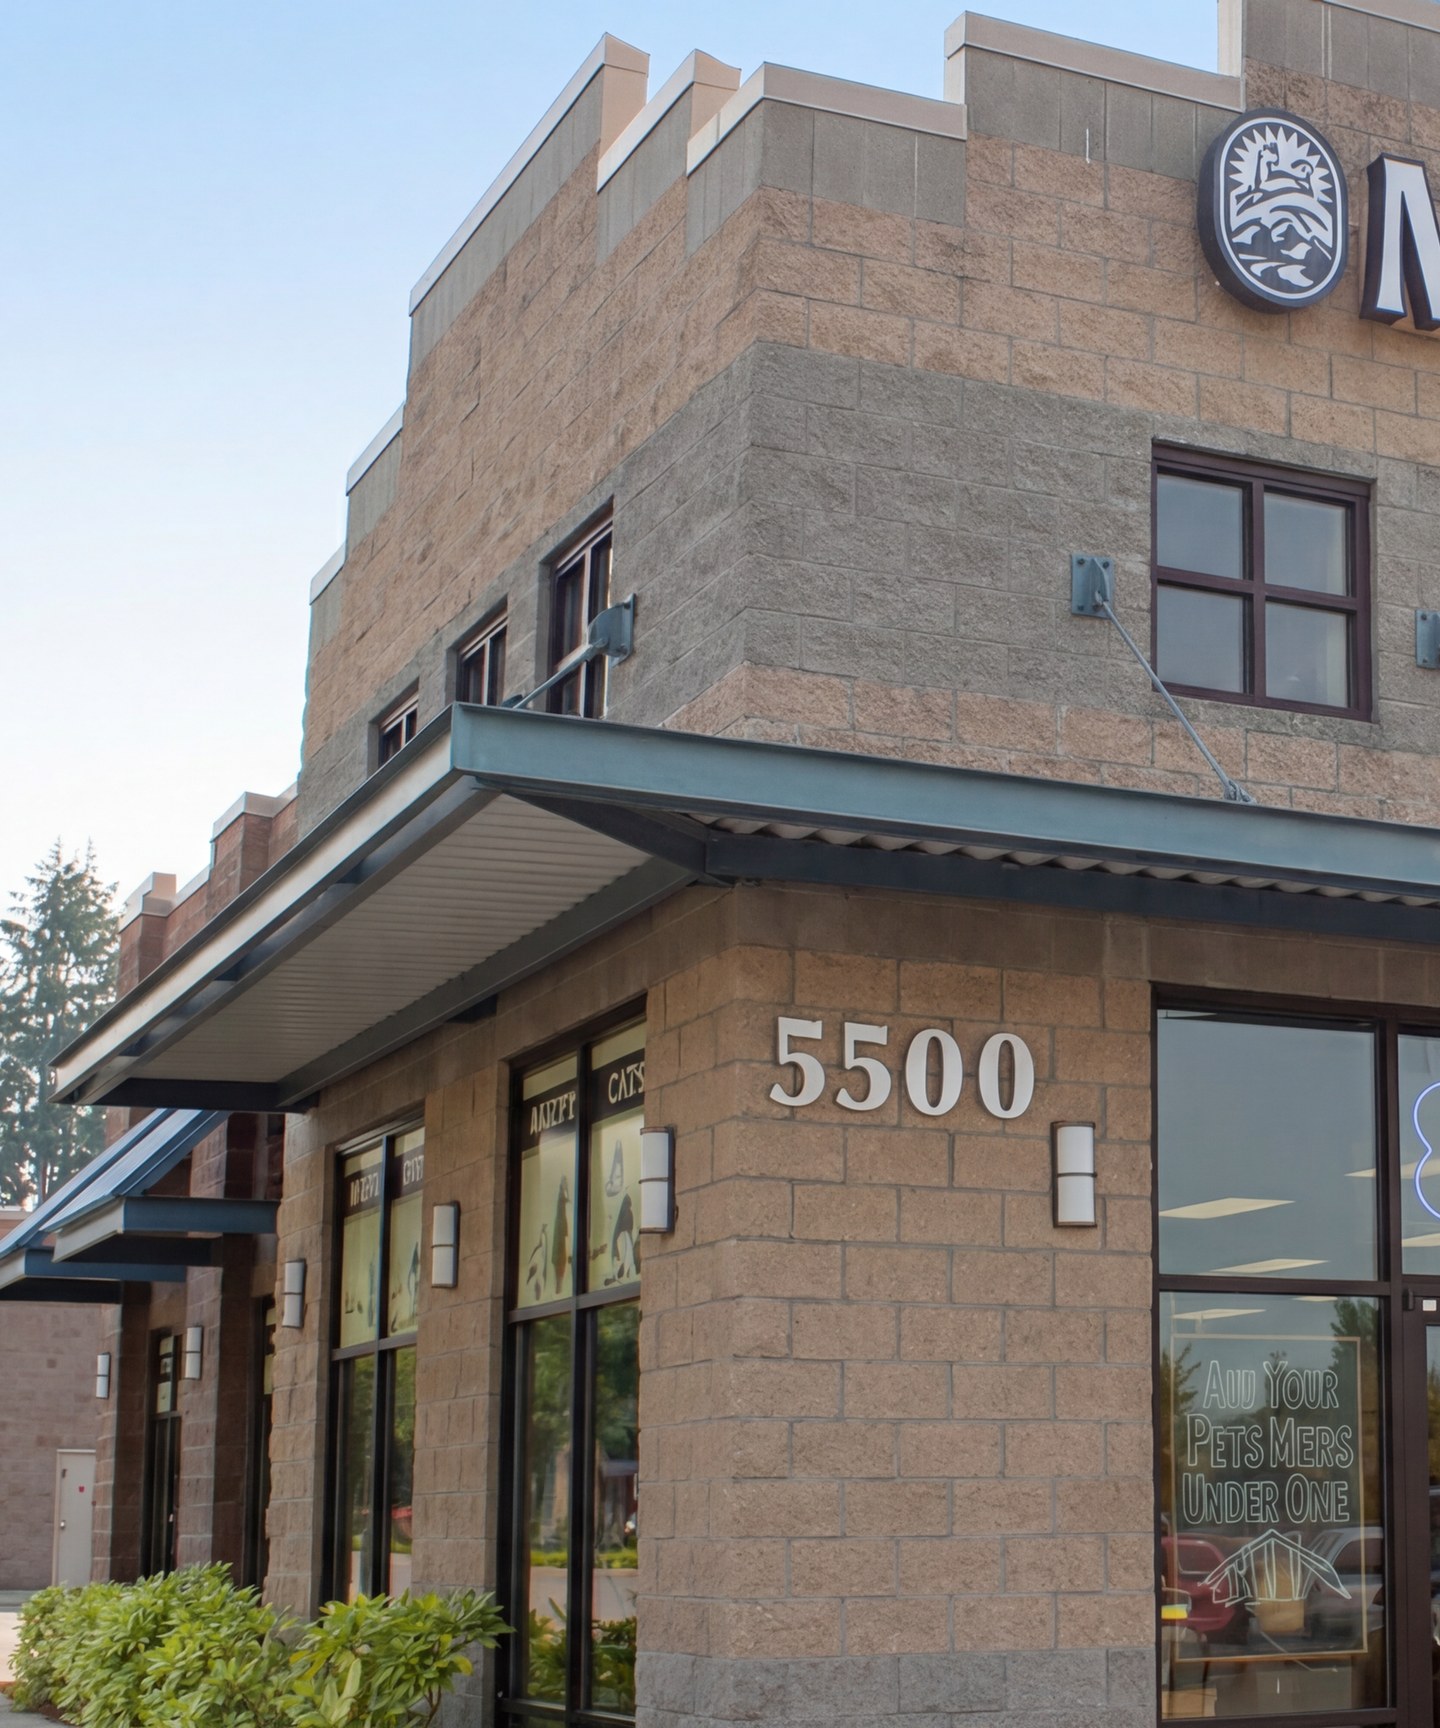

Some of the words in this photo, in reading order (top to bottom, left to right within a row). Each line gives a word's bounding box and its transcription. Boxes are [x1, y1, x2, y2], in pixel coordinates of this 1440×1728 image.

[768, 1016, 1035, 1119] 5500
[1263, 1361, 1339, 1409] YOUR
[1187, 1413, 1264, 1469] PETS
[1182, 1473, 1280, 1524] UNDER
[1285, 1473, 1350, 1523] ONE
